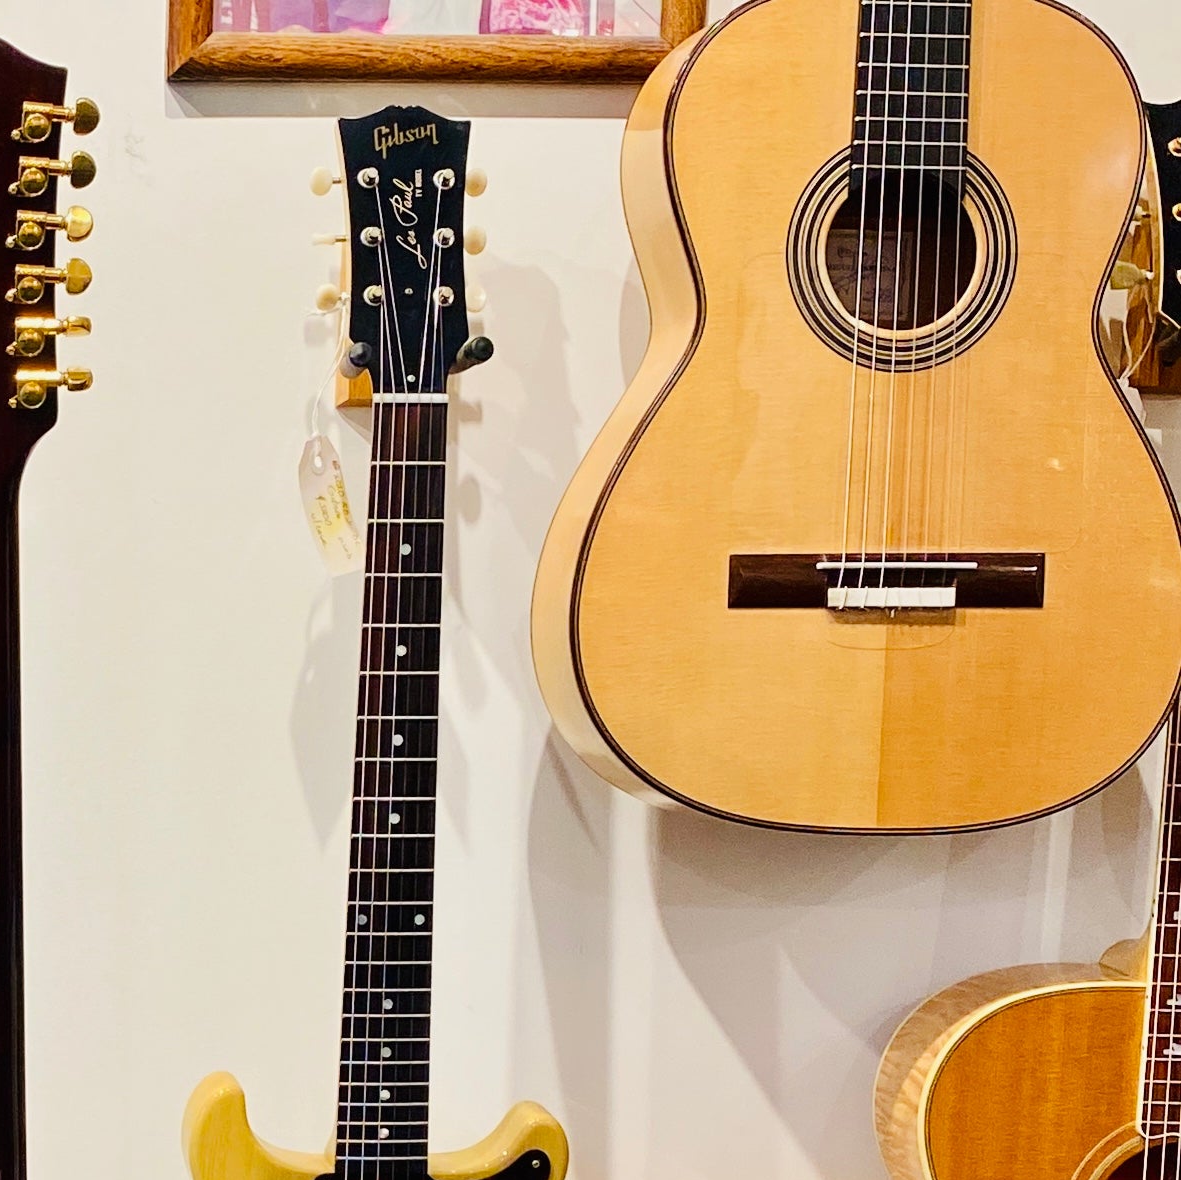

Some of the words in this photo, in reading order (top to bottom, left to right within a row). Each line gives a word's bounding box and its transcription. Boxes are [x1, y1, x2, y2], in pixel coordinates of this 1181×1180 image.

[373, 122, 440, 160] Gibson
[389, 178, 419, 227] Paul
[395, 230, 428, 270] Les
